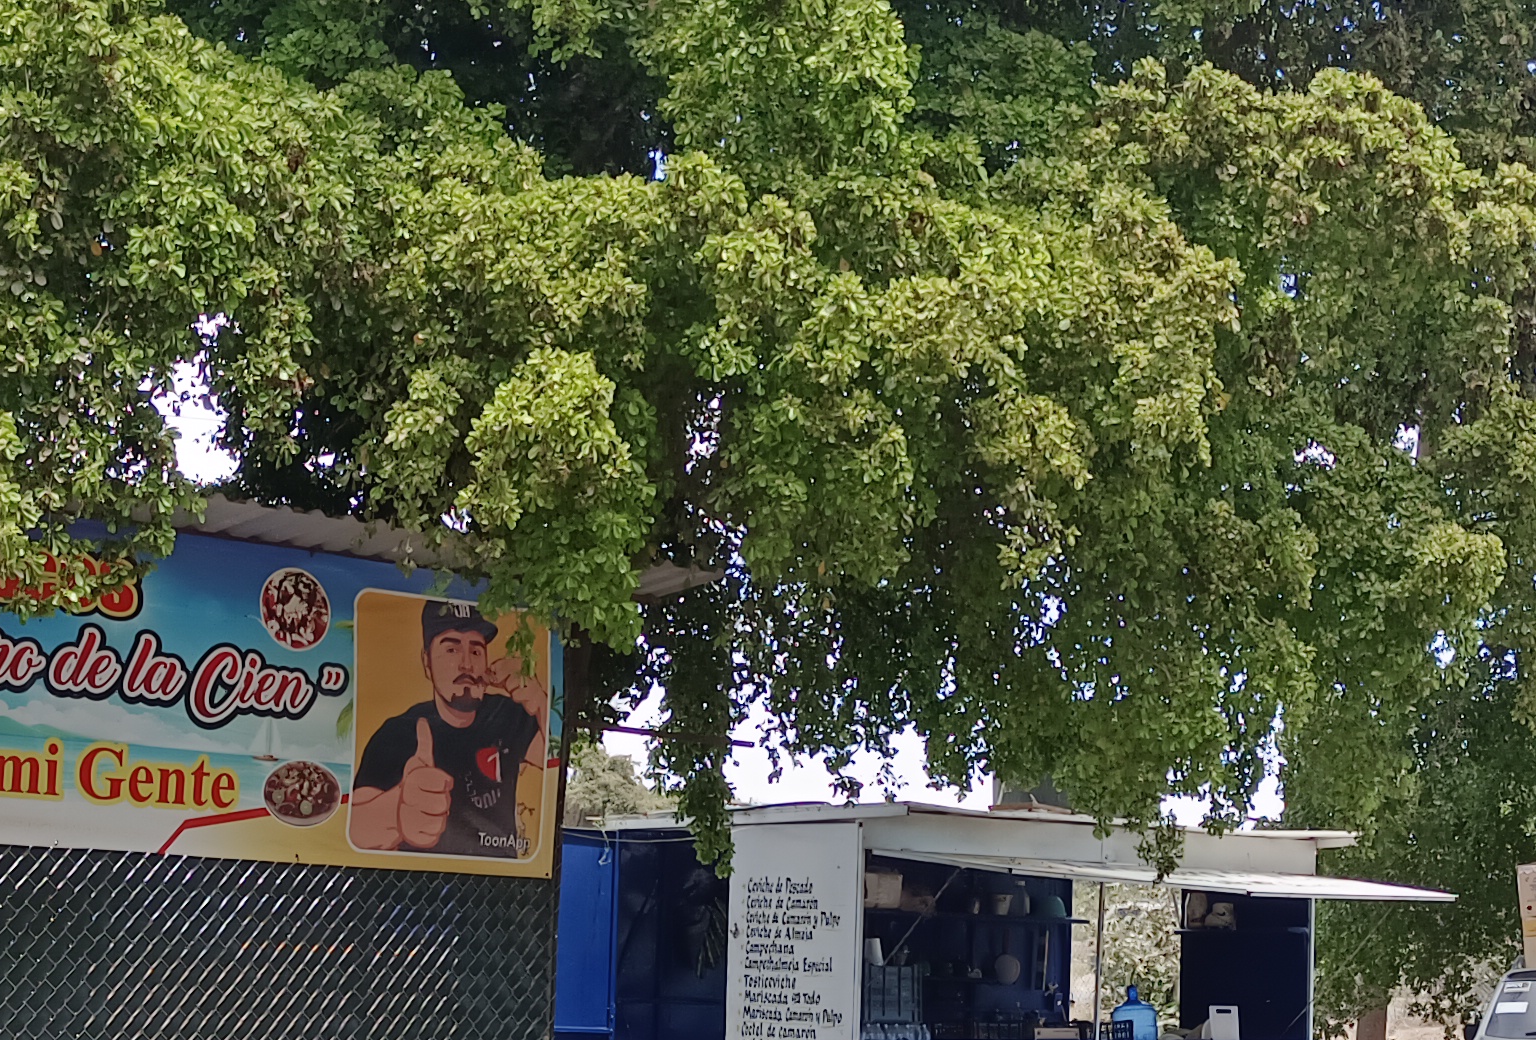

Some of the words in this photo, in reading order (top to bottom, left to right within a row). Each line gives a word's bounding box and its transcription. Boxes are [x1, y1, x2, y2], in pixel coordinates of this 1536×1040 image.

[52, 630, 118, 691] de
[127, 636, 183, 697] la
[78, 746, 236, 809] Gente
[477, 831, 531, 851] ToonApp
[747, 876, 773, 894] Ceviche
[775, 876, 783, 894] de
[785, 876, 813, 895] Pescado
[746, 895, 773, 910] Ceviche
[775, 896, 784, 910] de
[746, 911, 770, 925] Ceviche
[820, 911, 841, 928] Pulpo
[746, 924, 772, 939] Ceviche
[774, 926, 782, 939] de
[784, 926, 813, 941] Almeja
[802, 956, 833, 975] Especial
[741, 1021, 763, 1037] Coctel
[766, 1022, 776, 1038] de
